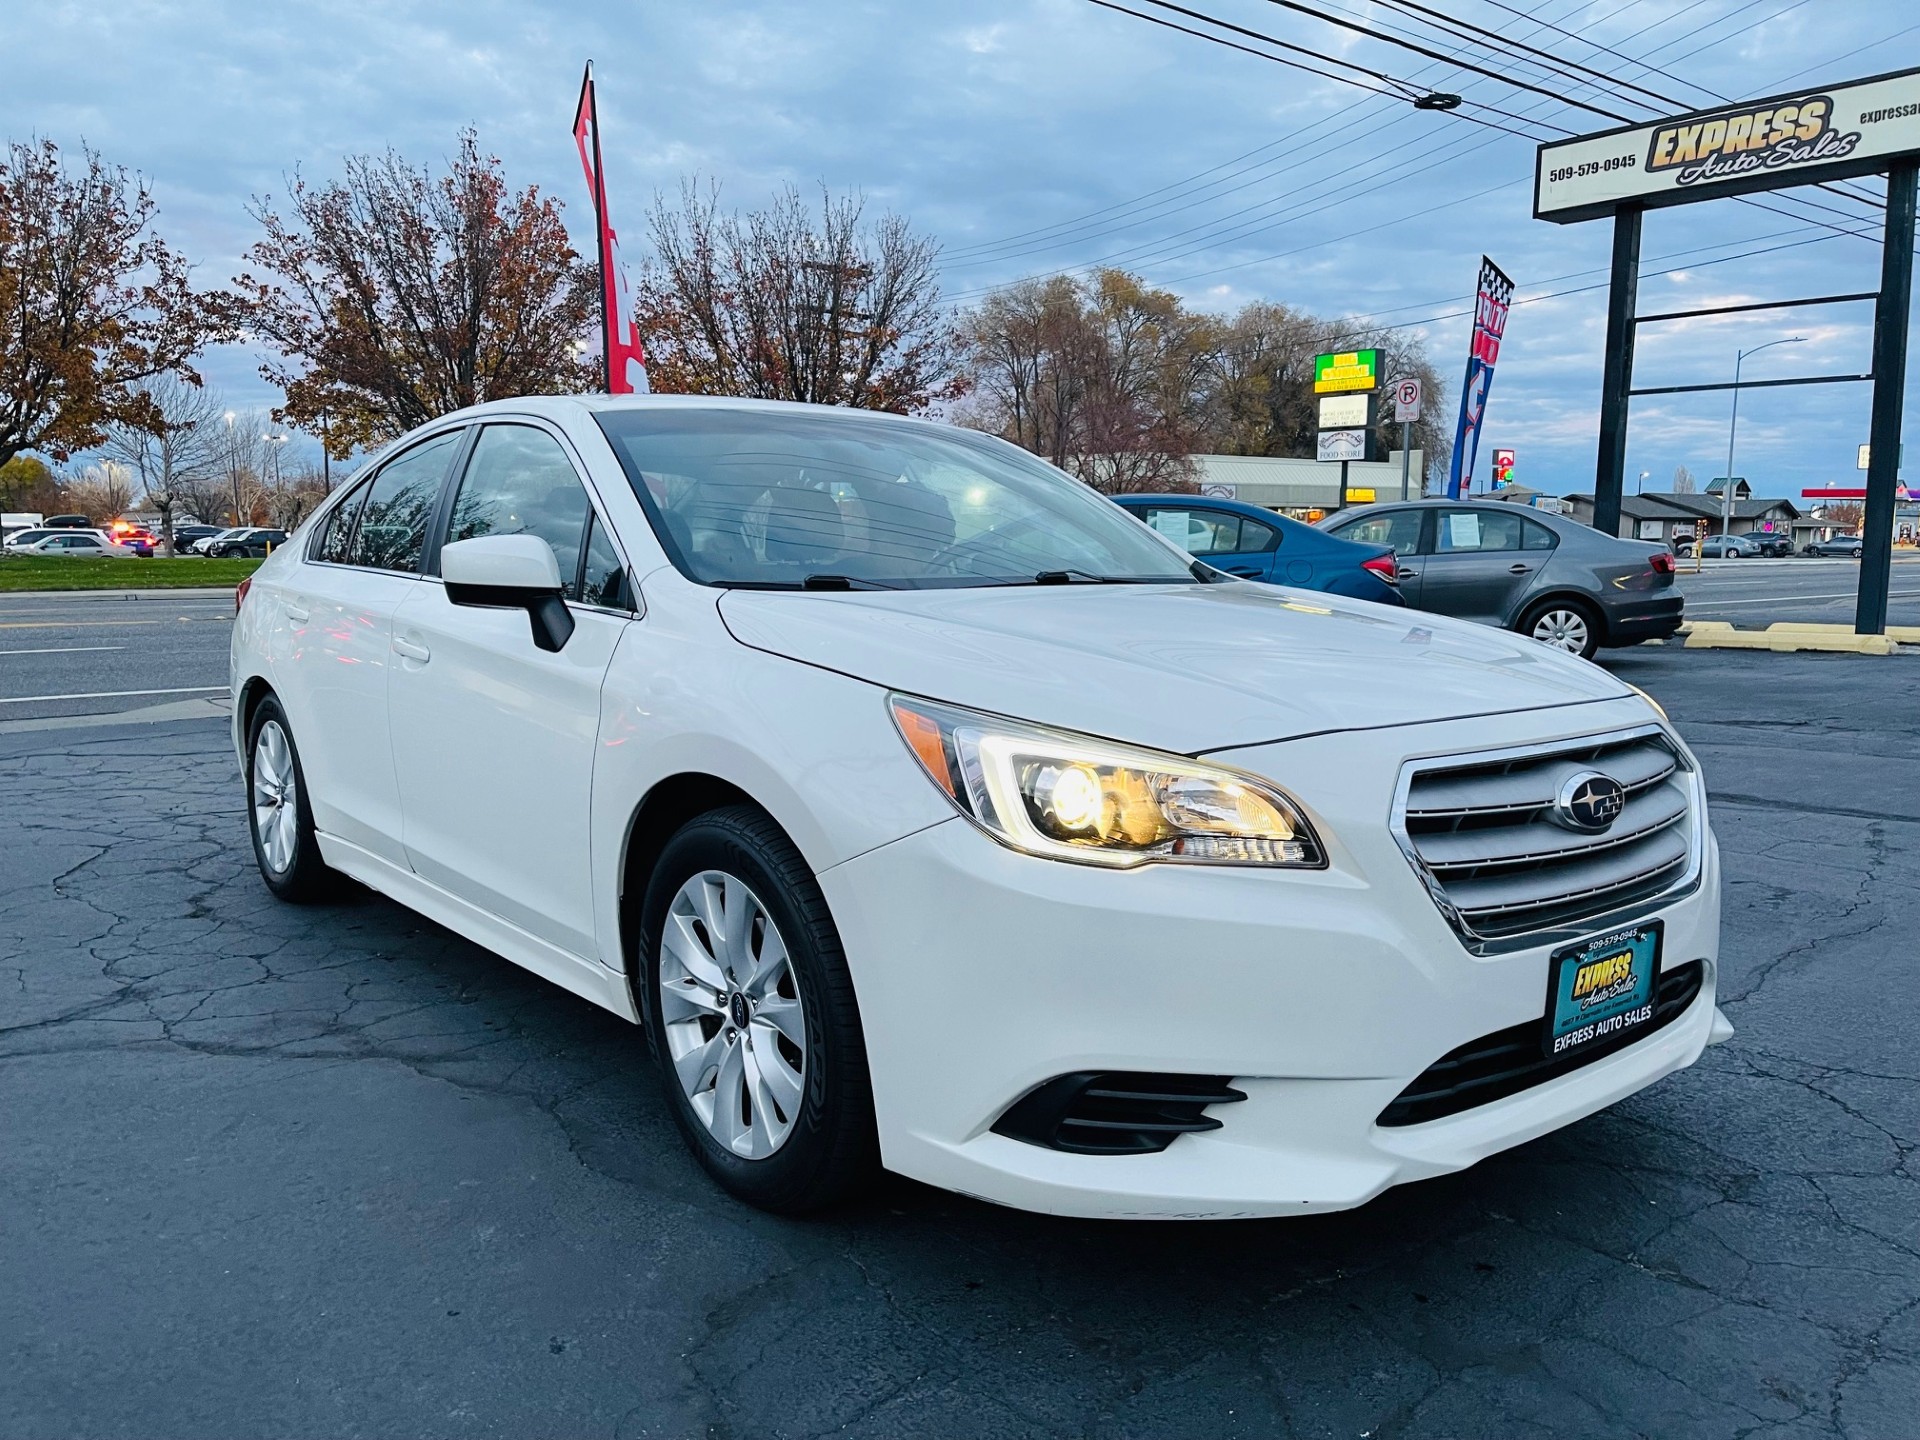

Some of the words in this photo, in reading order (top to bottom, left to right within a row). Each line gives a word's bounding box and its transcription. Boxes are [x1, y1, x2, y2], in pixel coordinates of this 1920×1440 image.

[1860, 103, 1920, 124] expressa
[1652, 101, 1826, 167] EXPRESS
[1550, 154, 1636, 182] 509-579-0945
[1679, 152, 1762, 184] Auto
[1766, 132, 1857, 166] Sales
[1320, 451, 1338, 459] FOOD
[1340, 450, 1362, 458] STORE
[1588, 928, 1638, 951] 509-579-0945
[1574, 952, 1632, 997] EXPRESS
[1582, 987, 1609, 1010] Auto
[1610, 974, 1637, 997] Sales
[1596, 1015, 1623, 1037] AUTO
[1624, 1004, 1652, 1027] SALES
